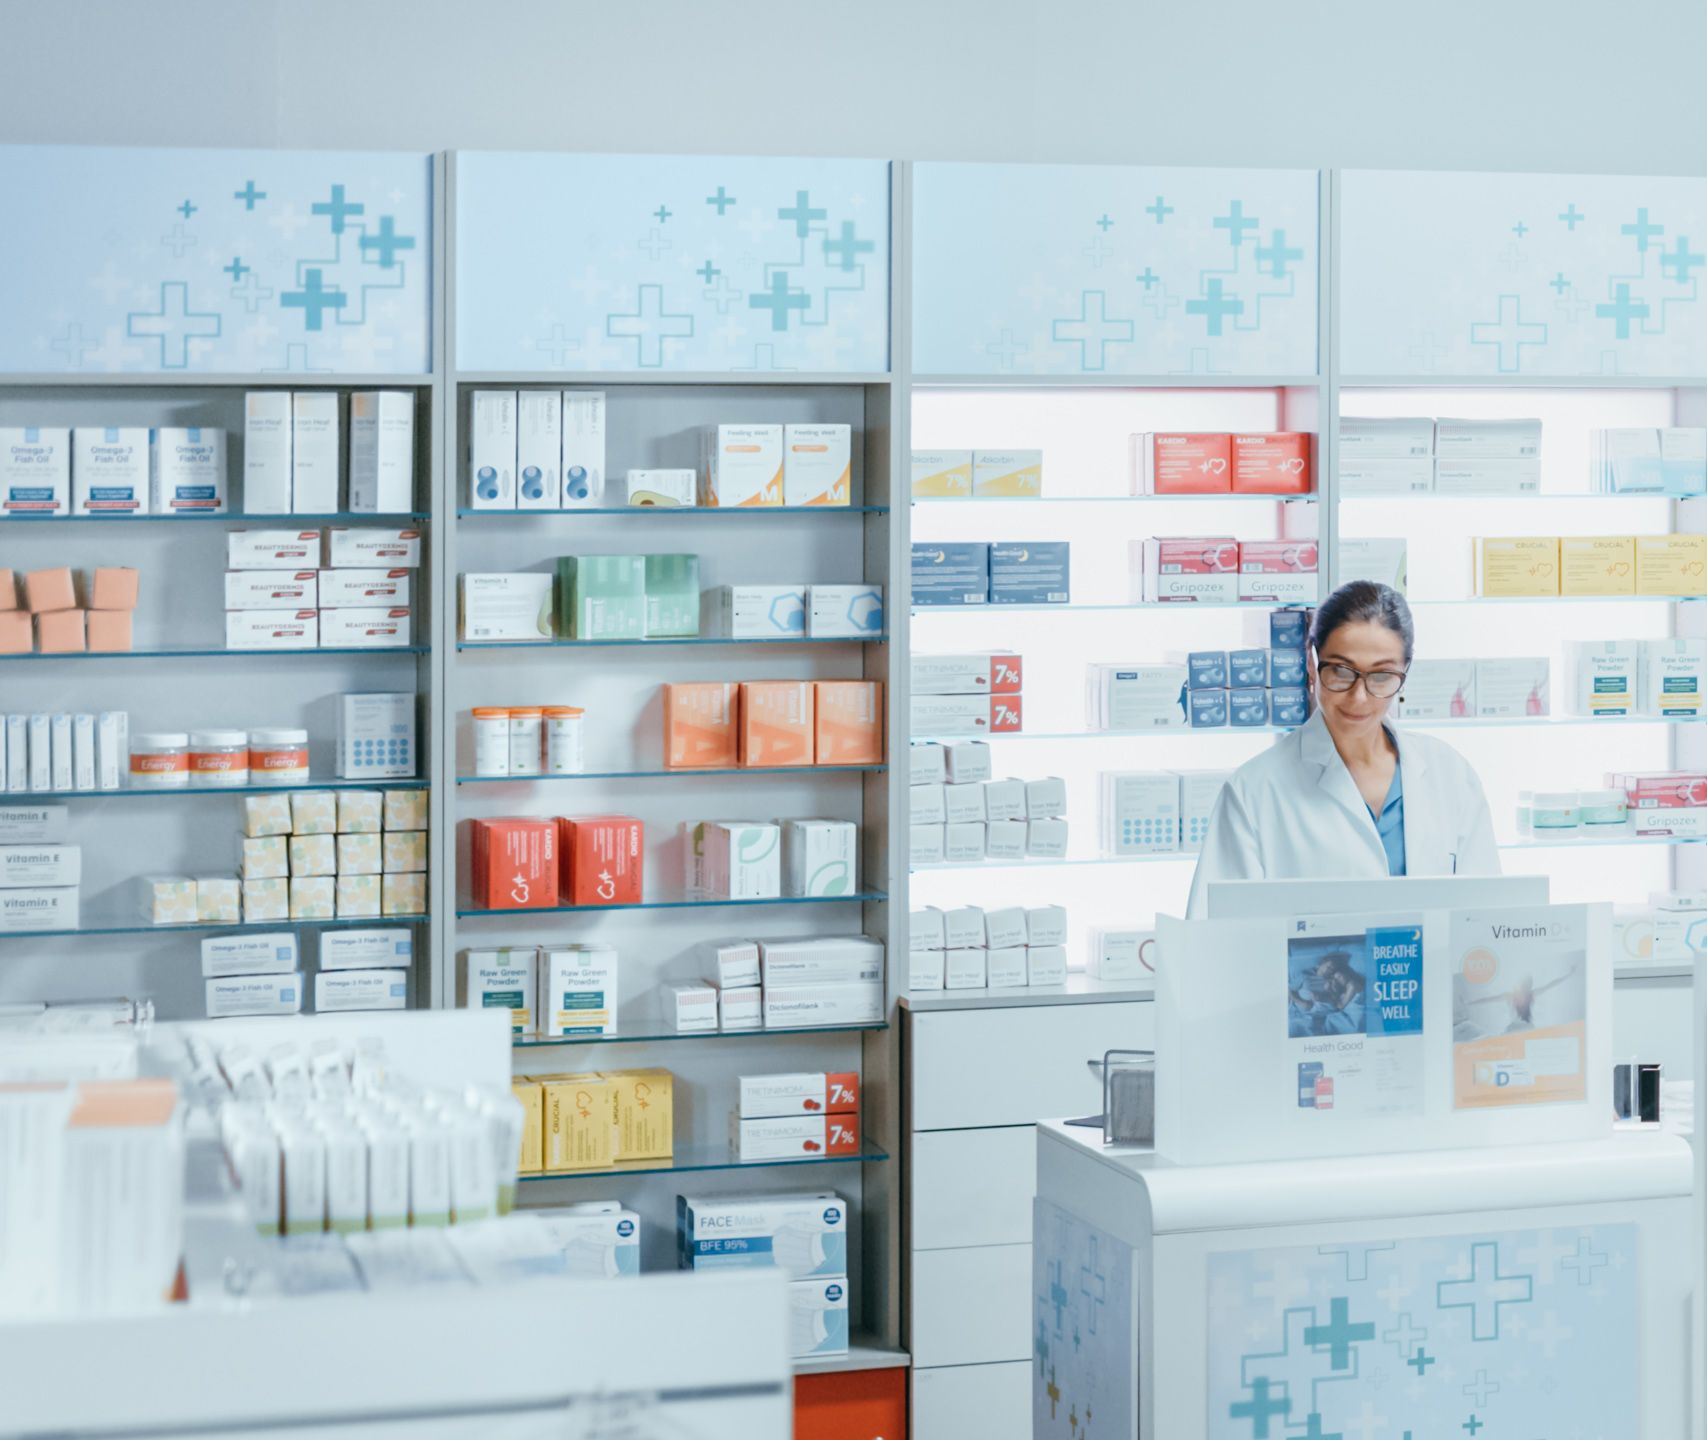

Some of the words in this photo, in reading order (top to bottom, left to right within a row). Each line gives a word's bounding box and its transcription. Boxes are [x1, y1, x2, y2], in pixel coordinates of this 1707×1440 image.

[10, 445, 54, 457] Omega-3
[90, 445, 134, 457] Omega-3
[175, 445, 214, 457] Omega-3
[14, 455, 33, 464] Fish
[35, 455, 50, 464] Oil
[95, 455, 113, 464] Fish
[115, 455, 129, 464] Oil
[179, 455, 196, 464] Fish
[198, 455, 210, 464] Oil
[980, 456, 1015, 464] Askorbin
[761, 484, 779, 501] M
[827, 484, 845, 501] M
[1593, 541, 1625, 549] CRUCIAL
[1667, 541, 1698, 549] CRUCIAL
[1169, 581, 1224, 594] Gripozex
[1250, 580, 1304, 593] Gripozex
[1591, 656, 1605, 664] Raw
[1608, 656, 1629, 664] Green
[1660, 656, 1675, 664] Raw
[1677, 656, 1700, 664] Green
[995, 664, 1019, 684] 7%
[1597, 664, 1623, 672] Powder
[1666, 664, 1693, 672] Powder
[995, 705, 1019, 725] 7%
[141, 759, 176, 772] Energy
[198, 758, 232, 771] Energy
[264, 757, 299, 770] Energy
[42, 812, 49, 821] E
[1647, 814, 1698, 828] Gripozex
[544, 829, 552, 860] KARDIO
[630, 825, 638, 856] KARDIO
[6, 854, 50, 864] Vitamin
[53, 853, 60, 863] E
[4, 898, 48, 909] Vitamin
[51, 897, 58, 907] E
[1492, 922, 1547, 940] Vitamin
[1373, 944, 1418, 960] BREATHE
[480, 968, 498, 977] Raw
[500, 968, 528, 977] Green
[561, 969, 578, 977] Raw
[581, 968, 608, 977] Green
[1380, 962, 1411, 976] EASILY
[487, 978, 519, 987] Powder
[568, 978, 601, 987] Powder
[1373, 980, 1418, 1003] SLEEP
[1382, 1005, 1411, 1020] WELL
[1303, 1042, 1335, 1054] Health
[1337, 1040, 1364, 1053] Good
[1496, 1070, 1510, 1087] D
[830, 1085, 855, 1104] 7%
[830, 1126, 855, 1145] 7%
[700, 1215, 733, 1229] FACE
[735, 1214, 767, 1227] Mask
[700, 1239, 721, 1252] BFE
[724, 1238, 748, 1251] 95%
